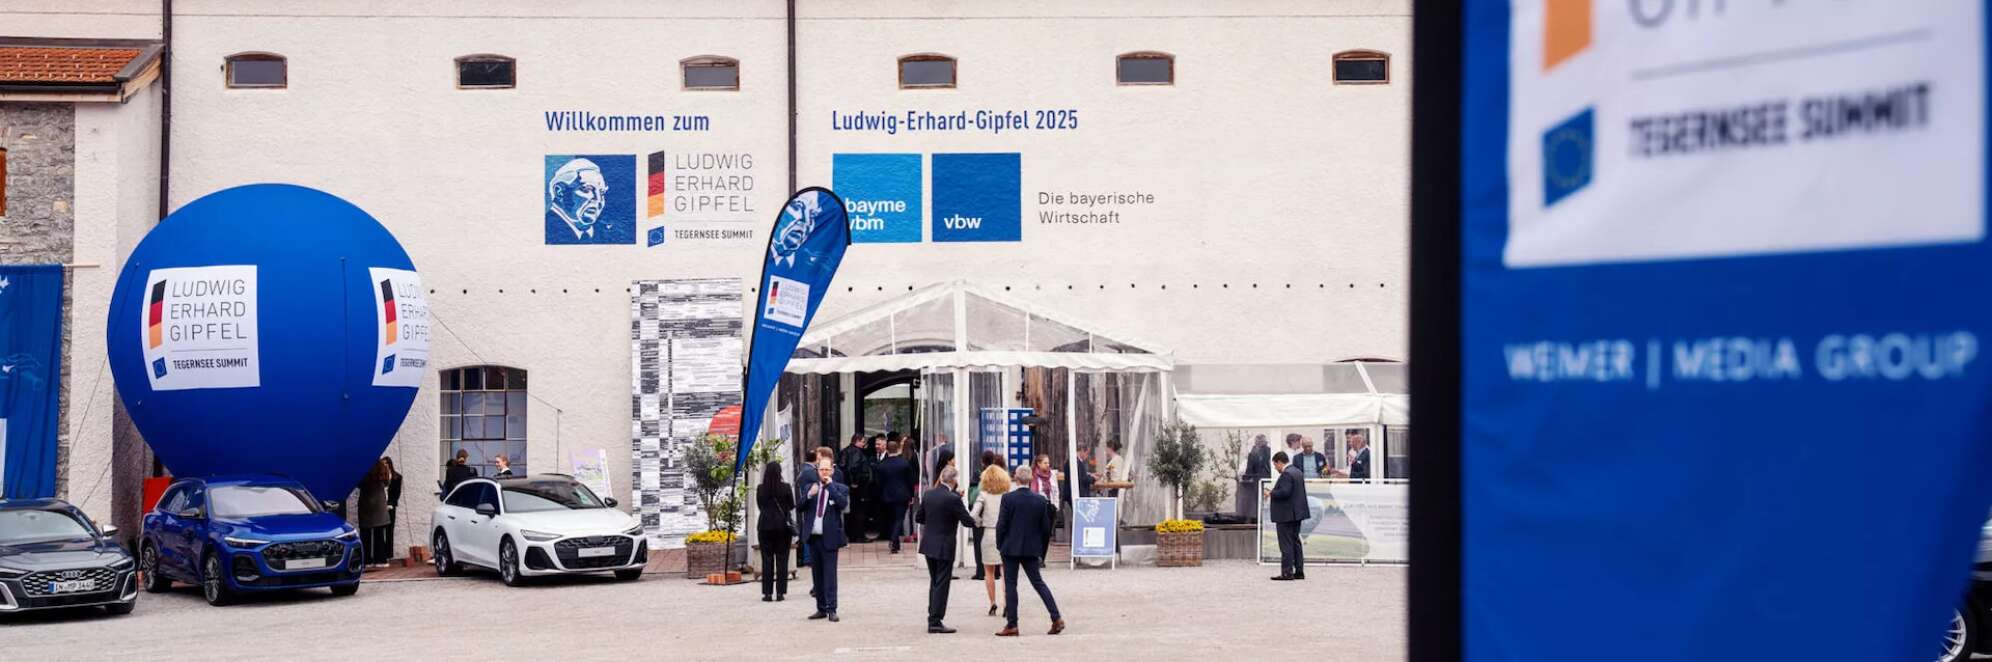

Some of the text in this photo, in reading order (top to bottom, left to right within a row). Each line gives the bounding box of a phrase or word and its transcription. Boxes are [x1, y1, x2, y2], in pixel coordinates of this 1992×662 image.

[545, 111, 709, 131] Willkommen zum
[833, 110, 1078, 134] Ludwig-Erhard-Gipfel 2025
[1628, 83, 1930, 157] TEGERNSEE SUMMIT
[676, 153, 752, 169] LUDWIG
[675, 175, 753, 191] ERHARD
[674, 195, 754, 212] GIPFEL
[845, 197, 906, 216] bayme
[1039, 191, 1154, 207] Die bayerische
[944, 213, 982, 229] vbw
[1039, 210, 1120, 224] Wirtschaft
[674, 229, 753, 240] TEGERNSEE SUMMIT
[172, 279, 245, 298] LUDWIG
[170, 301, 246, 320] ERHARD
[170, 323, 248, 342] GIPFEL
[172, 358, 248, 370] TEGERNSEE SUMMIT
[1673, 336, 1800, 383] MEDIA
[1815, 331, 1979, 382] GROUP
